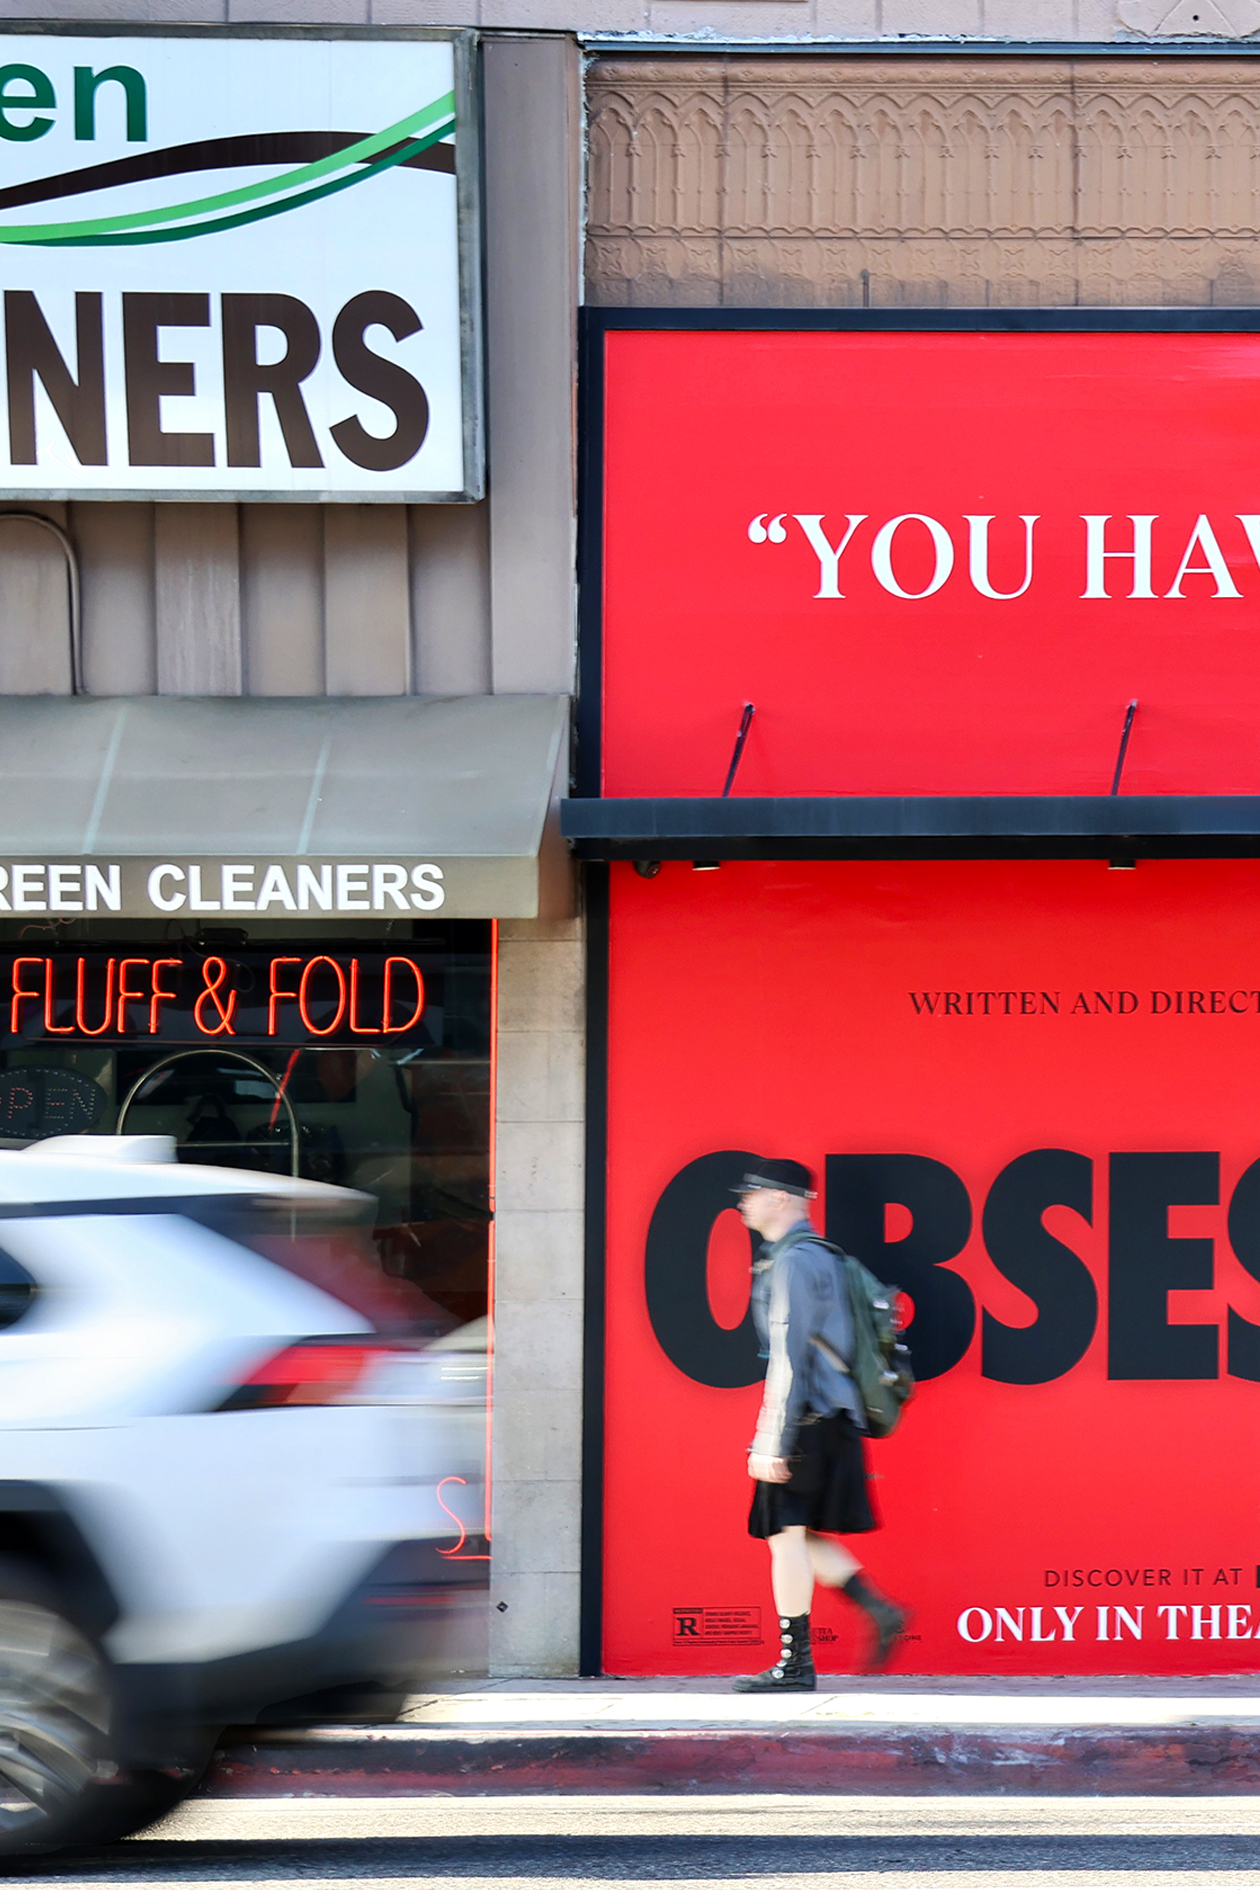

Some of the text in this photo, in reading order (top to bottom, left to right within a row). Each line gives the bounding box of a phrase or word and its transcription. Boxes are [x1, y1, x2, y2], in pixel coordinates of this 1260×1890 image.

[748, 513, 1040, 600] “YOU
[147, 863, 445, 911] CLEANERS
[10, 955, 425, 1036] FLUFF & FOLD
[908, 991, 1060, 1015] WRITTEN
[1071, 991, 1139, 1015] AND
[0, 1086, 96, 1120] PEN
[1044, 1568, 1172, 1588] DISCOVER
[1183, 1568, 1205, 1586] IT
[1213, 1567, 1243, 1585] AT
[676, 1617, 700, 1637] R
[957, 1606, 1084, 1643] ONLY
[1096, 1605, 1144, 1641] IN
